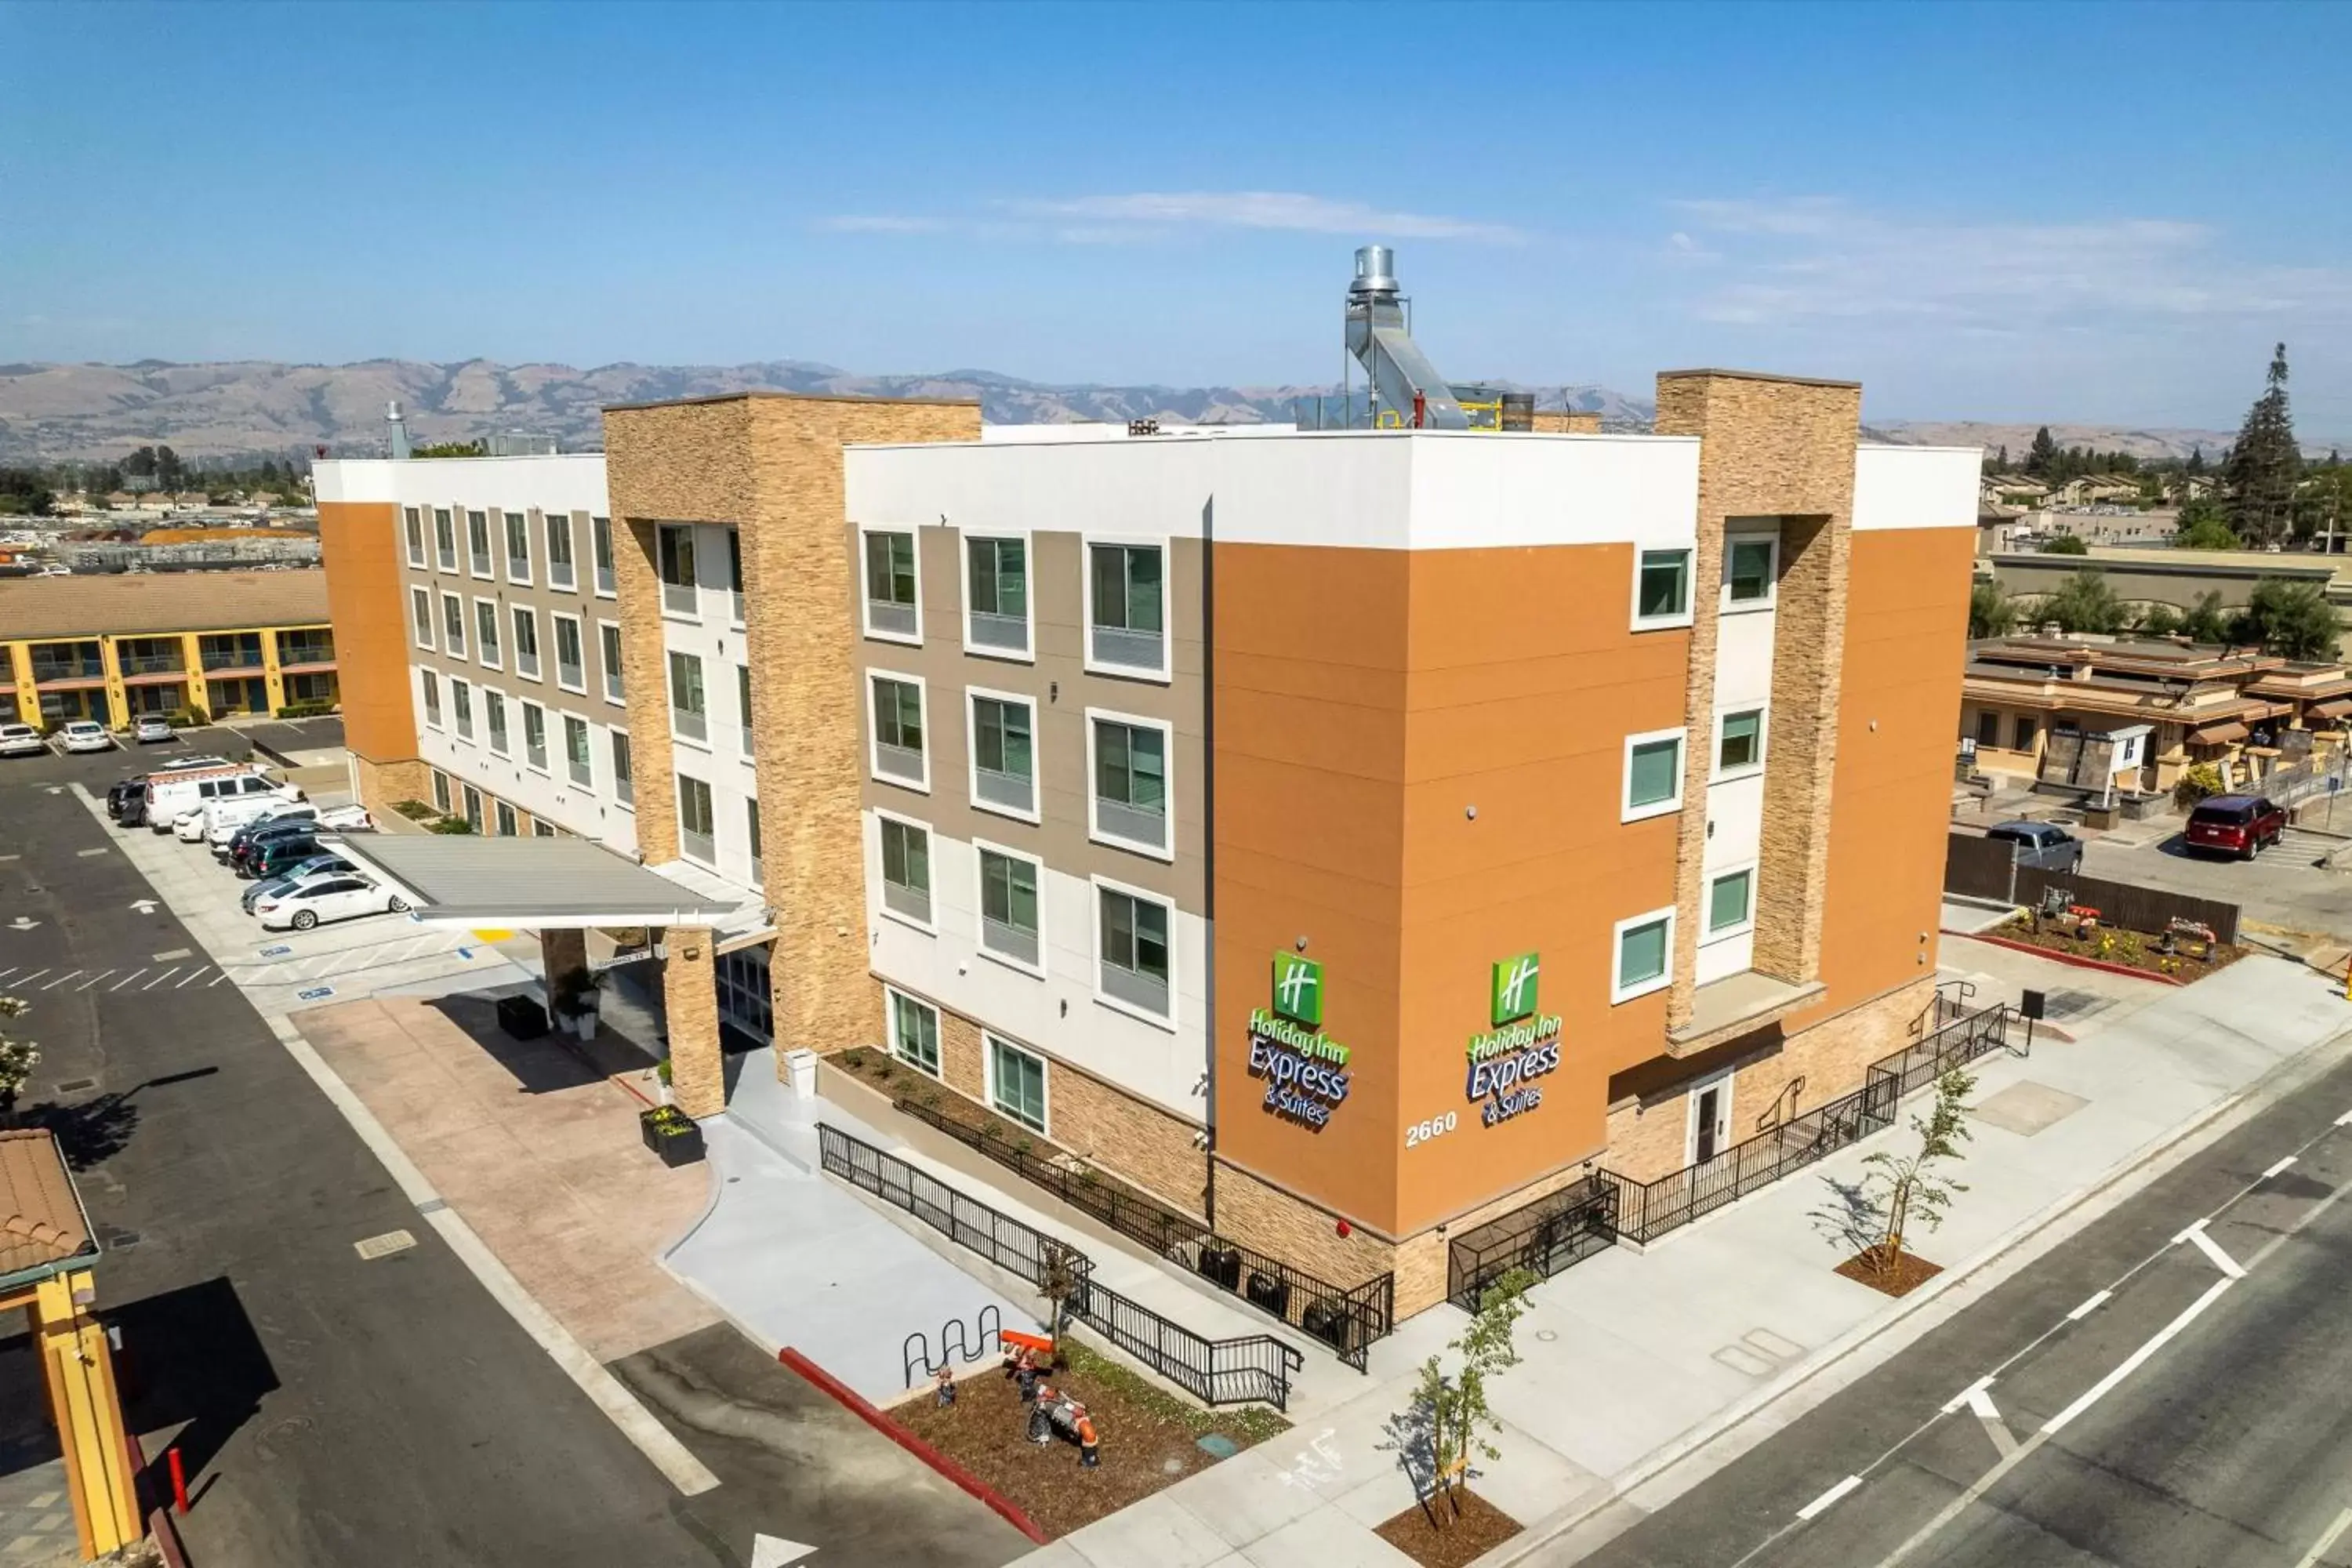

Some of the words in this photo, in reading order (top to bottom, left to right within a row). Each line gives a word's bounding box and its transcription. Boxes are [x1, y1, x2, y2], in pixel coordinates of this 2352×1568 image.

[1250, 1009, 1313, 1058] Holiday
[1316, 1033, 1345, 1065] Inn
[1471, 1025, 1536, 1062] Holiday
[1537, 1015, 1563, 1037] Inn
[1250, 1036, 1345, 1101] Express
[1472, 1043, 1561, 1098] Express
[1265, 1084, 1276, 1104] &
[1279, 1090, 1324, 1126] Suites
[1486, 1102, 1498, 1123] &
[1501, 1087, 1543, 1119] Suites
[1405, 1111, 1457, 1149] 2660
